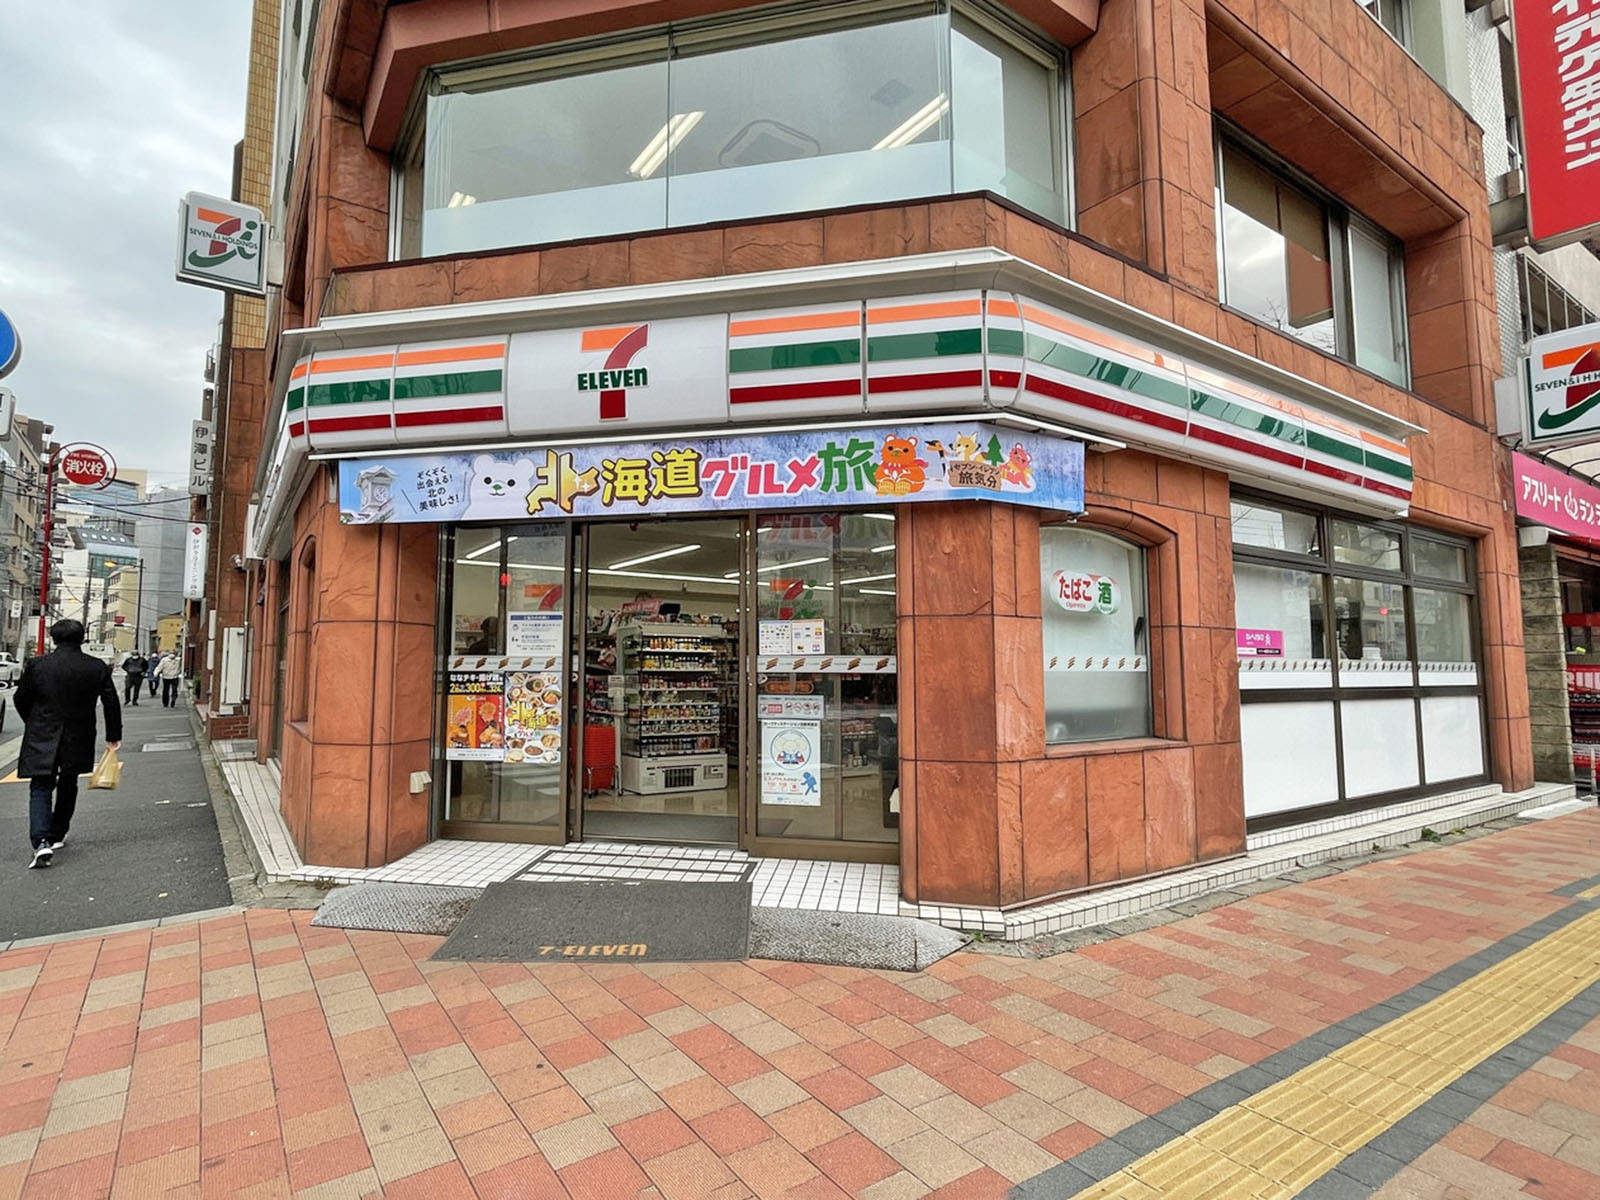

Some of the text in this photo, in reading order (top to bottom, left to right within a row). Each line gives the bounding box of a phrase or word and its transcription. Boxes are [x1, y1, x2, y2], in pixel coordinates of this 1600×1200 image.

[65, 458, 104, 477] 消火栓
[959, 470, 997, 488] 旅気分
[428, 486, 446, 498] 北の
[1521, 474, 1562, 513] アスリート
[1059, 576, 1092, 601] たばこ
[1098, 581, 1111, 604] 酒
